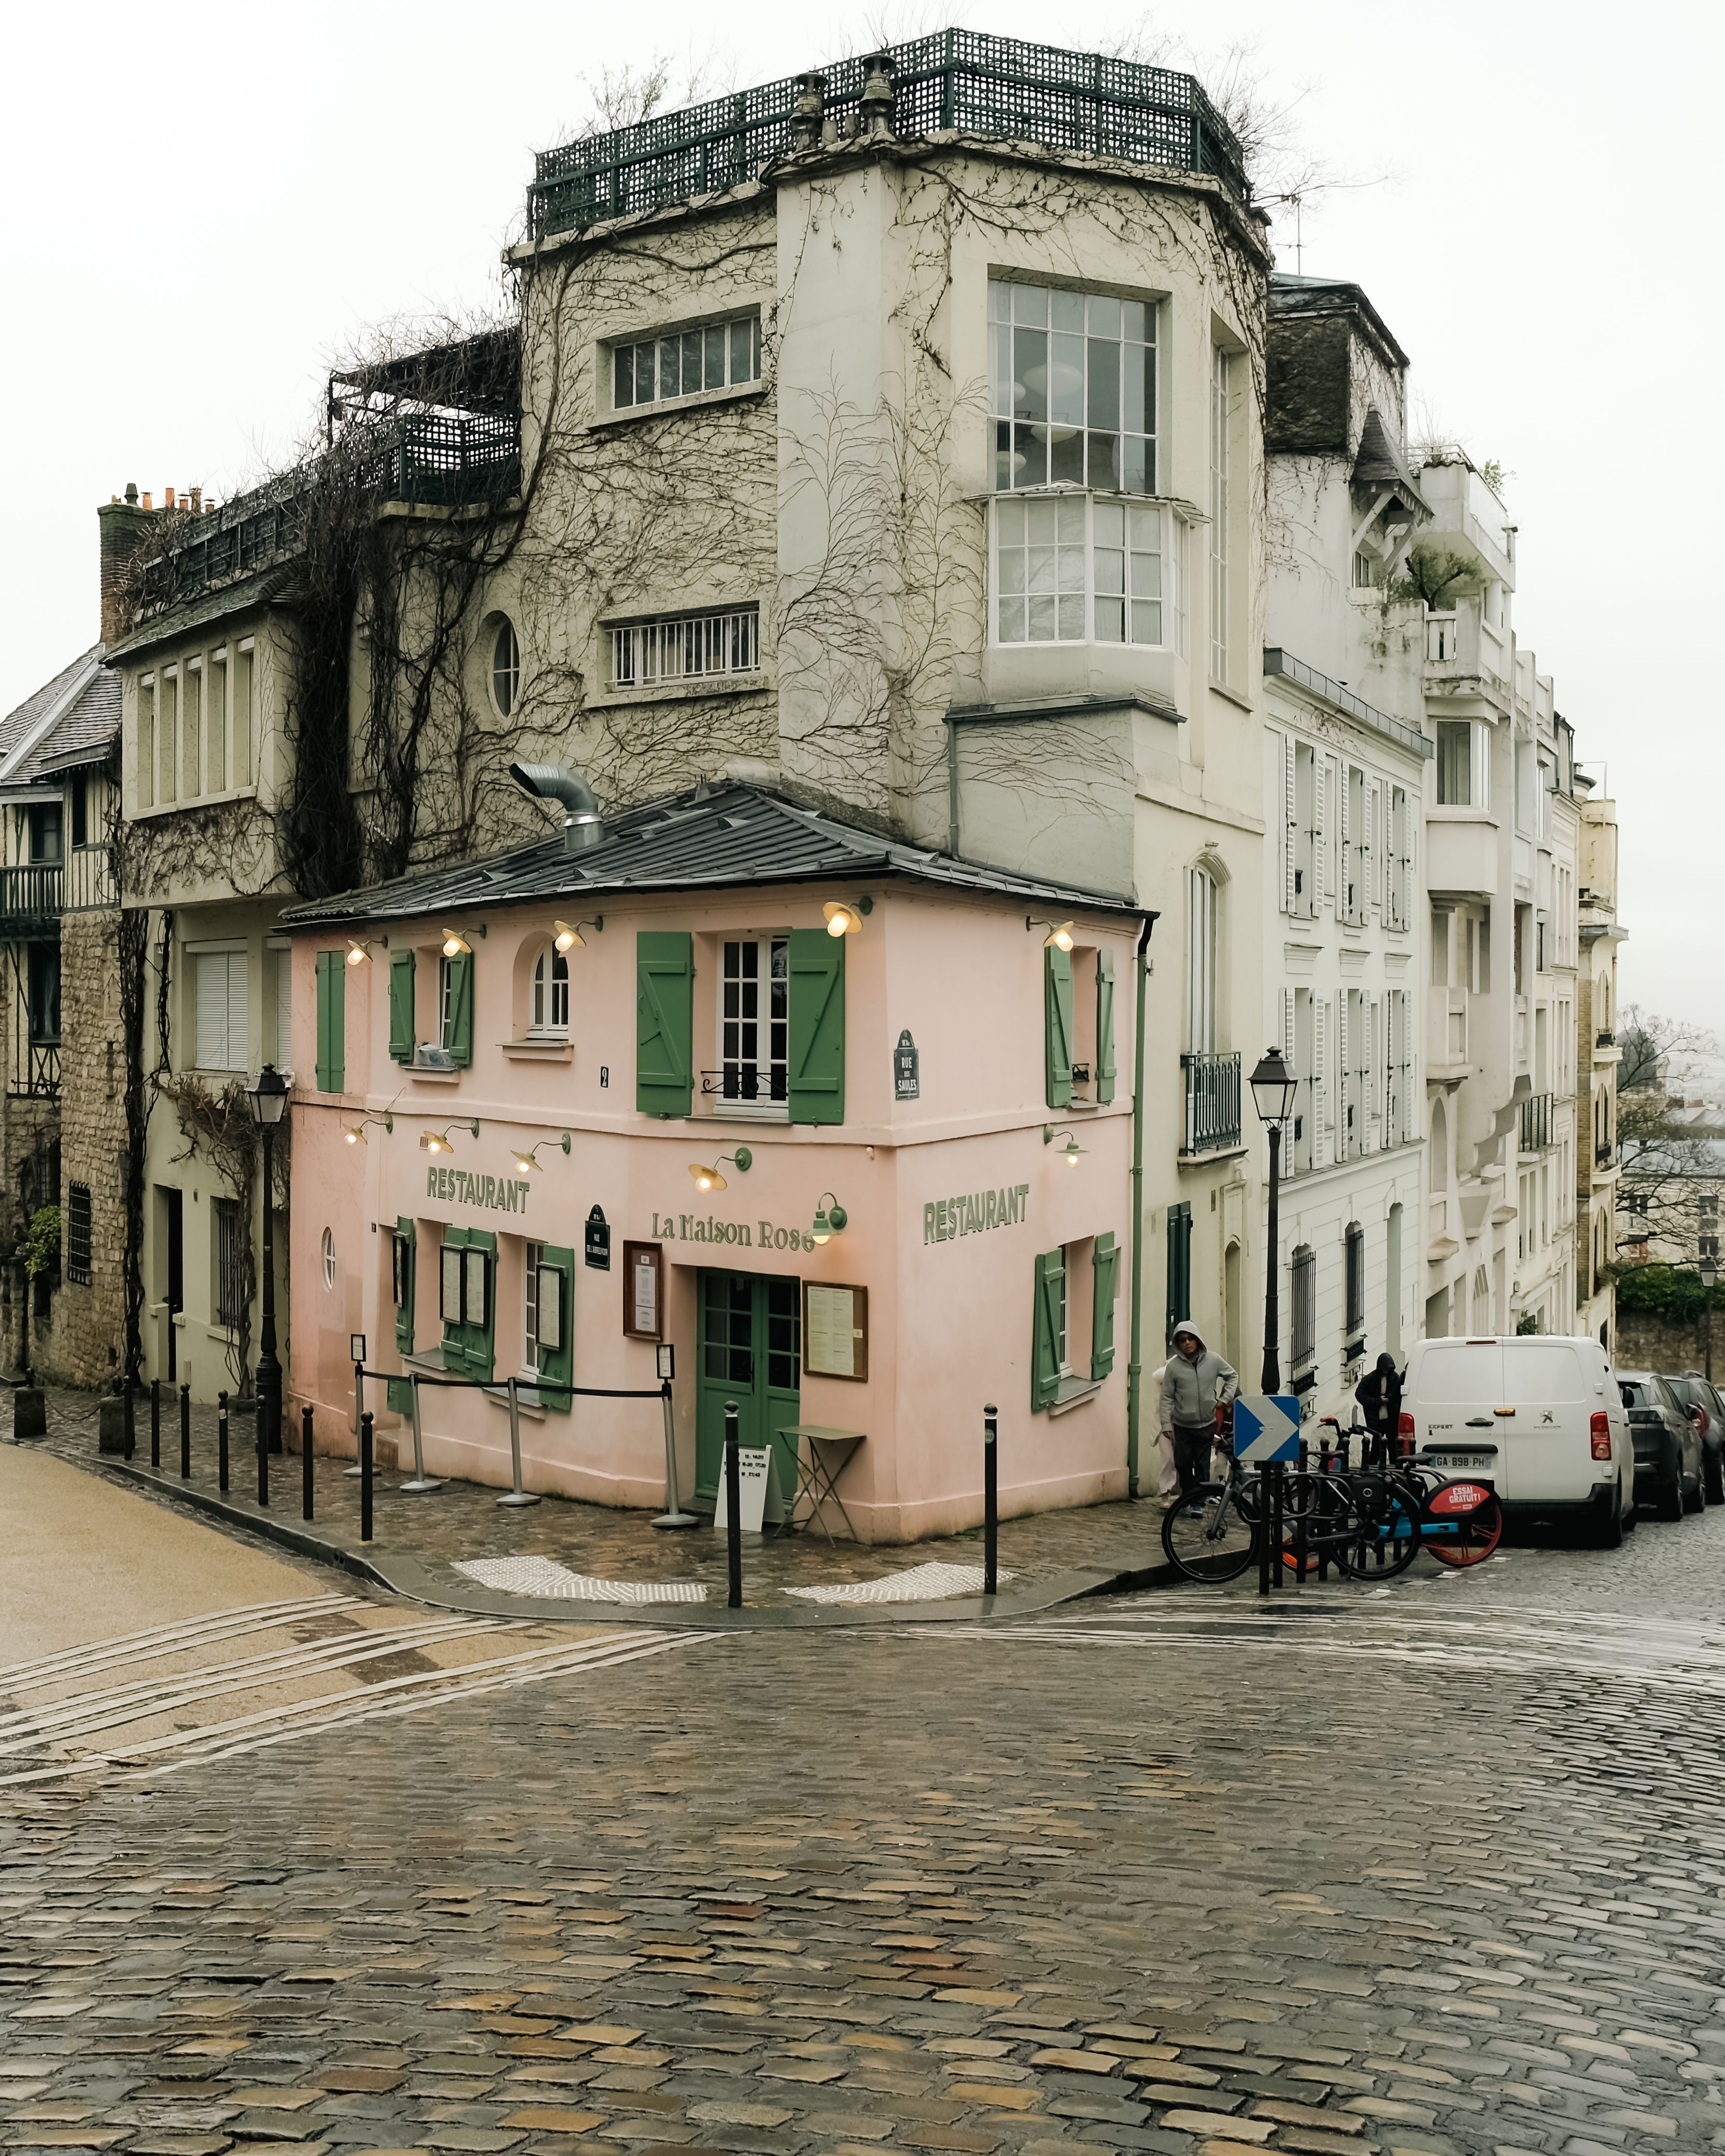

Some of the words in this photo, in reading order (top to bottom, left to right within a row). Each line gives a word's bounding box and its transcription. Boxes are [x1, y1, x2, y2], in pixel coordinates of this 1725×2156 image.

[901, 1057, 912, 1069] RUE
[602, 1068, 607, 1087] 2
[898, 1079, 917, 1091] SAULES
[427, 1166, 530, 1214] RESTAURANT
[924, 1184, 1029, 1245] RESTAURANT
[652, 1213, 675, 1240] La
[679, 1214, 752, 1247] Maison
[758, 1221, 815, 1253] Rose
[1437, 1457, 1484, 1467] GA-898-PH
[1453, 1486, 1473, 1495] ESSAI
